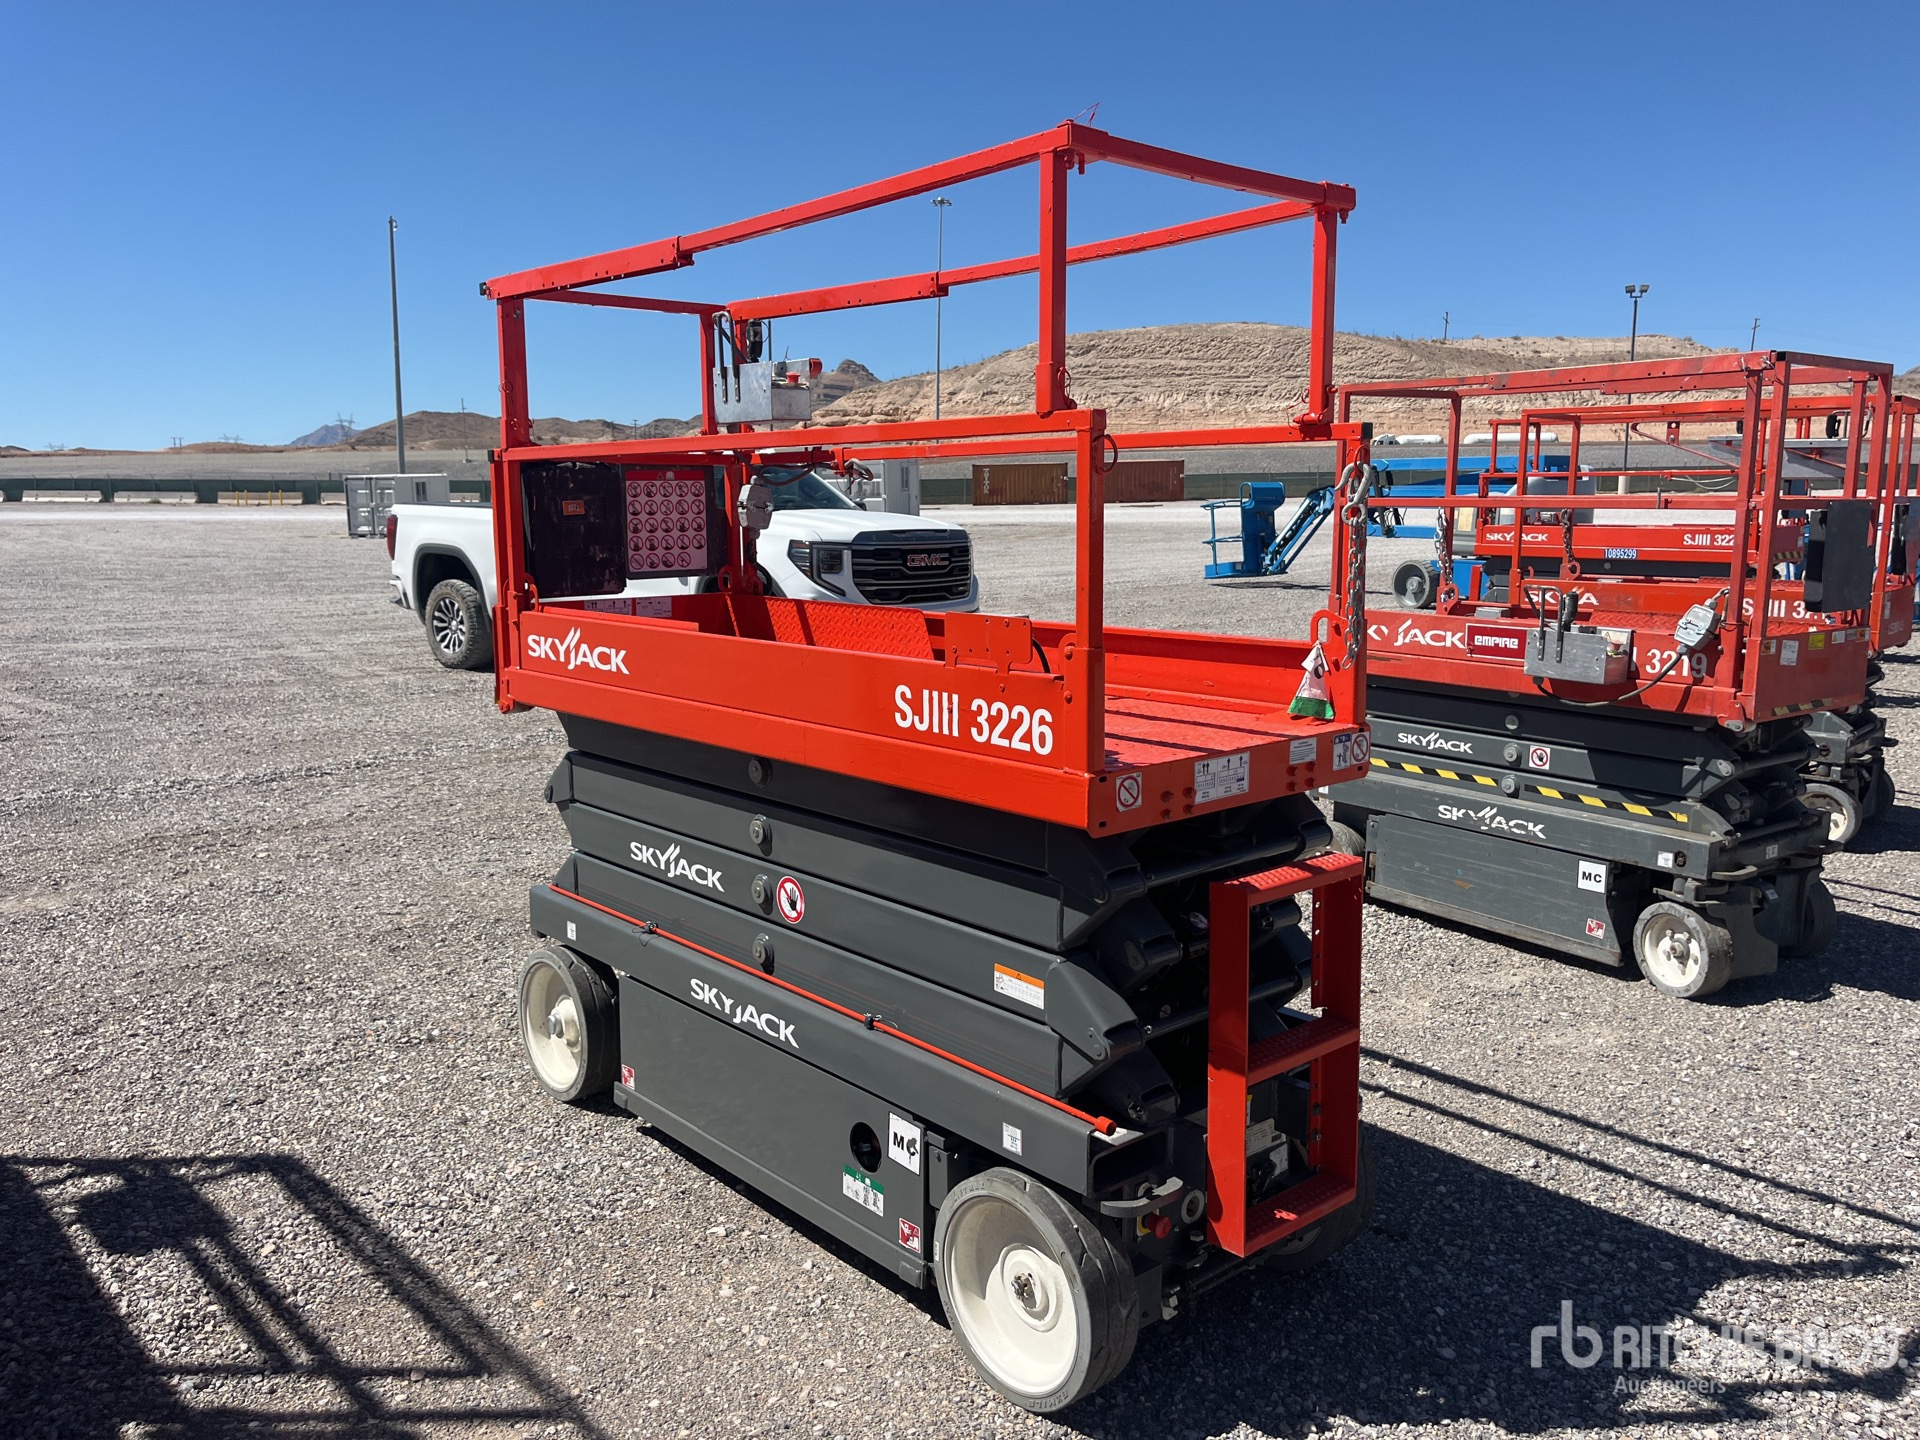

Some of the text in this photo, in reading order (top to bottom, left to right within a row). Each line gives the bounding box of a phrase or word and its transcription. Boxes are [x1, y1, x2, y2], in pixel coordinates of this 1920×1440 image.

[1486, 531, 1548, 543] SKYACK
[1714, 535, 1735, 546] 322
[907, 553, 949, 567] GMC
[1604, 549, 1637, 559] 10895299
[527, 626, 630, 675] SKYJACK
[1474, 635, 1518, 649] EMPIRE
[1645, 649, 1707, 678] 3219
[894, 685, 1054, 756] SJIII 3226
[1397, 731, 1473, 754] SKYJACK
[630, 841, 725, 893] SKYJACK
[1581, 871, 1602, 883] MC
[690, 978, 799, 1049] SKYJACK
